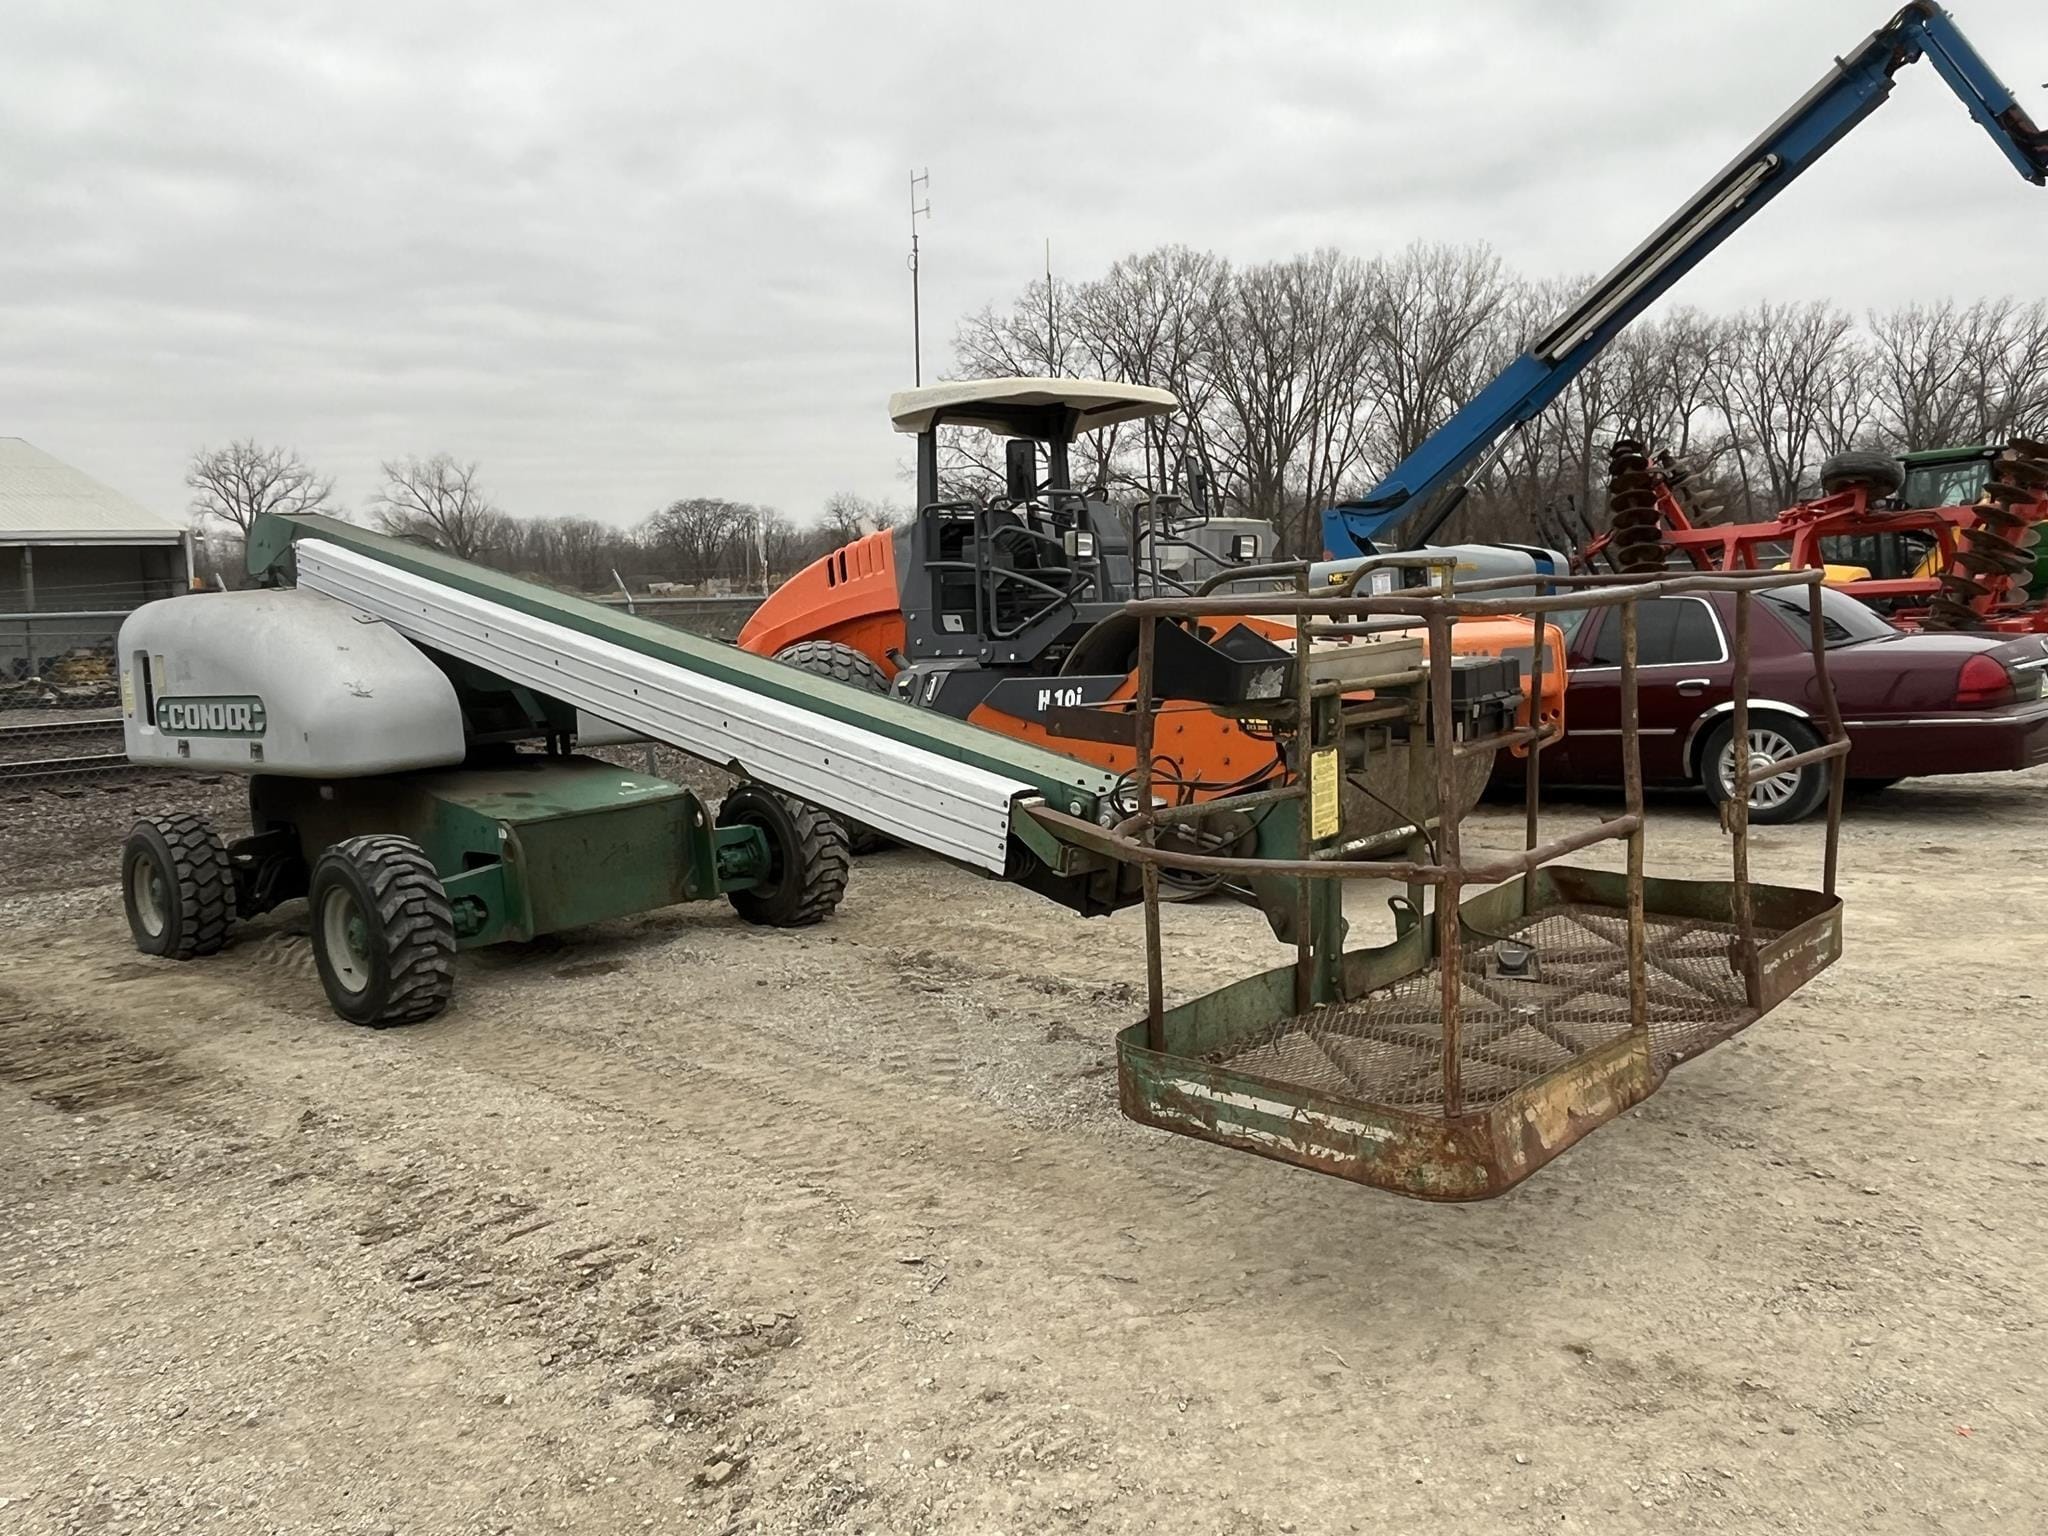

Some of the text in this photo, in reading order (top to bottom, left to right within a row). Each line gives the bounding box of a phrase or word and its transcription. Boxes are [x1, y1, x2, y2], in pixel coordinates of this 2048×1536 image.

[1038, 686, 1083, 711] H 10i
[168, 703, 254, 732] CONDOR
